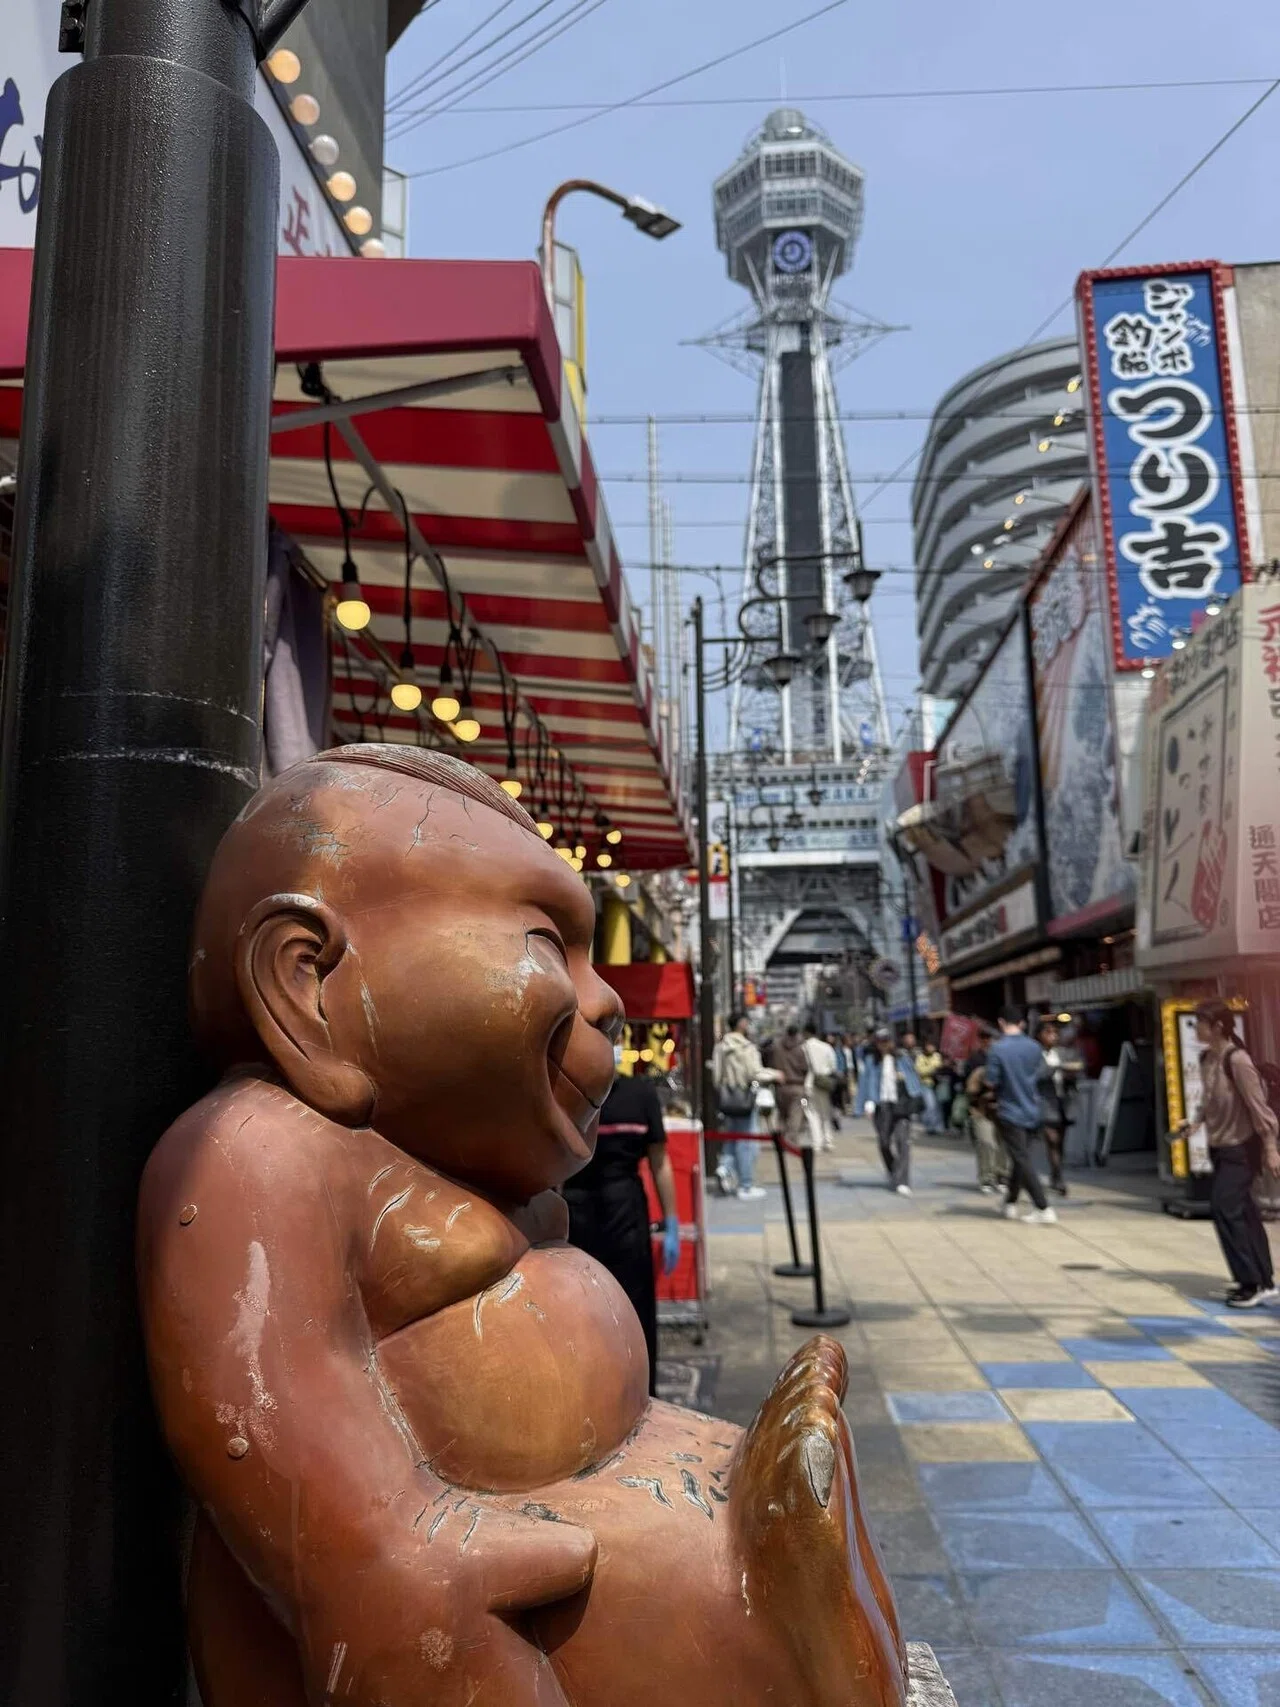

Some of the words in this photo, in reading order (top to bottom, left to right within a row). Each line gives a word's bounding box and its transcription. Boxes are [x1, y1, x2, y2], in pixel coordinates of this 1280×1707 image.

[1107, 316, 1153, 374] 釣船
[1147, 281, 1191, 372] ジャンボ
[1114, 381, 1224, 595] つり吉
